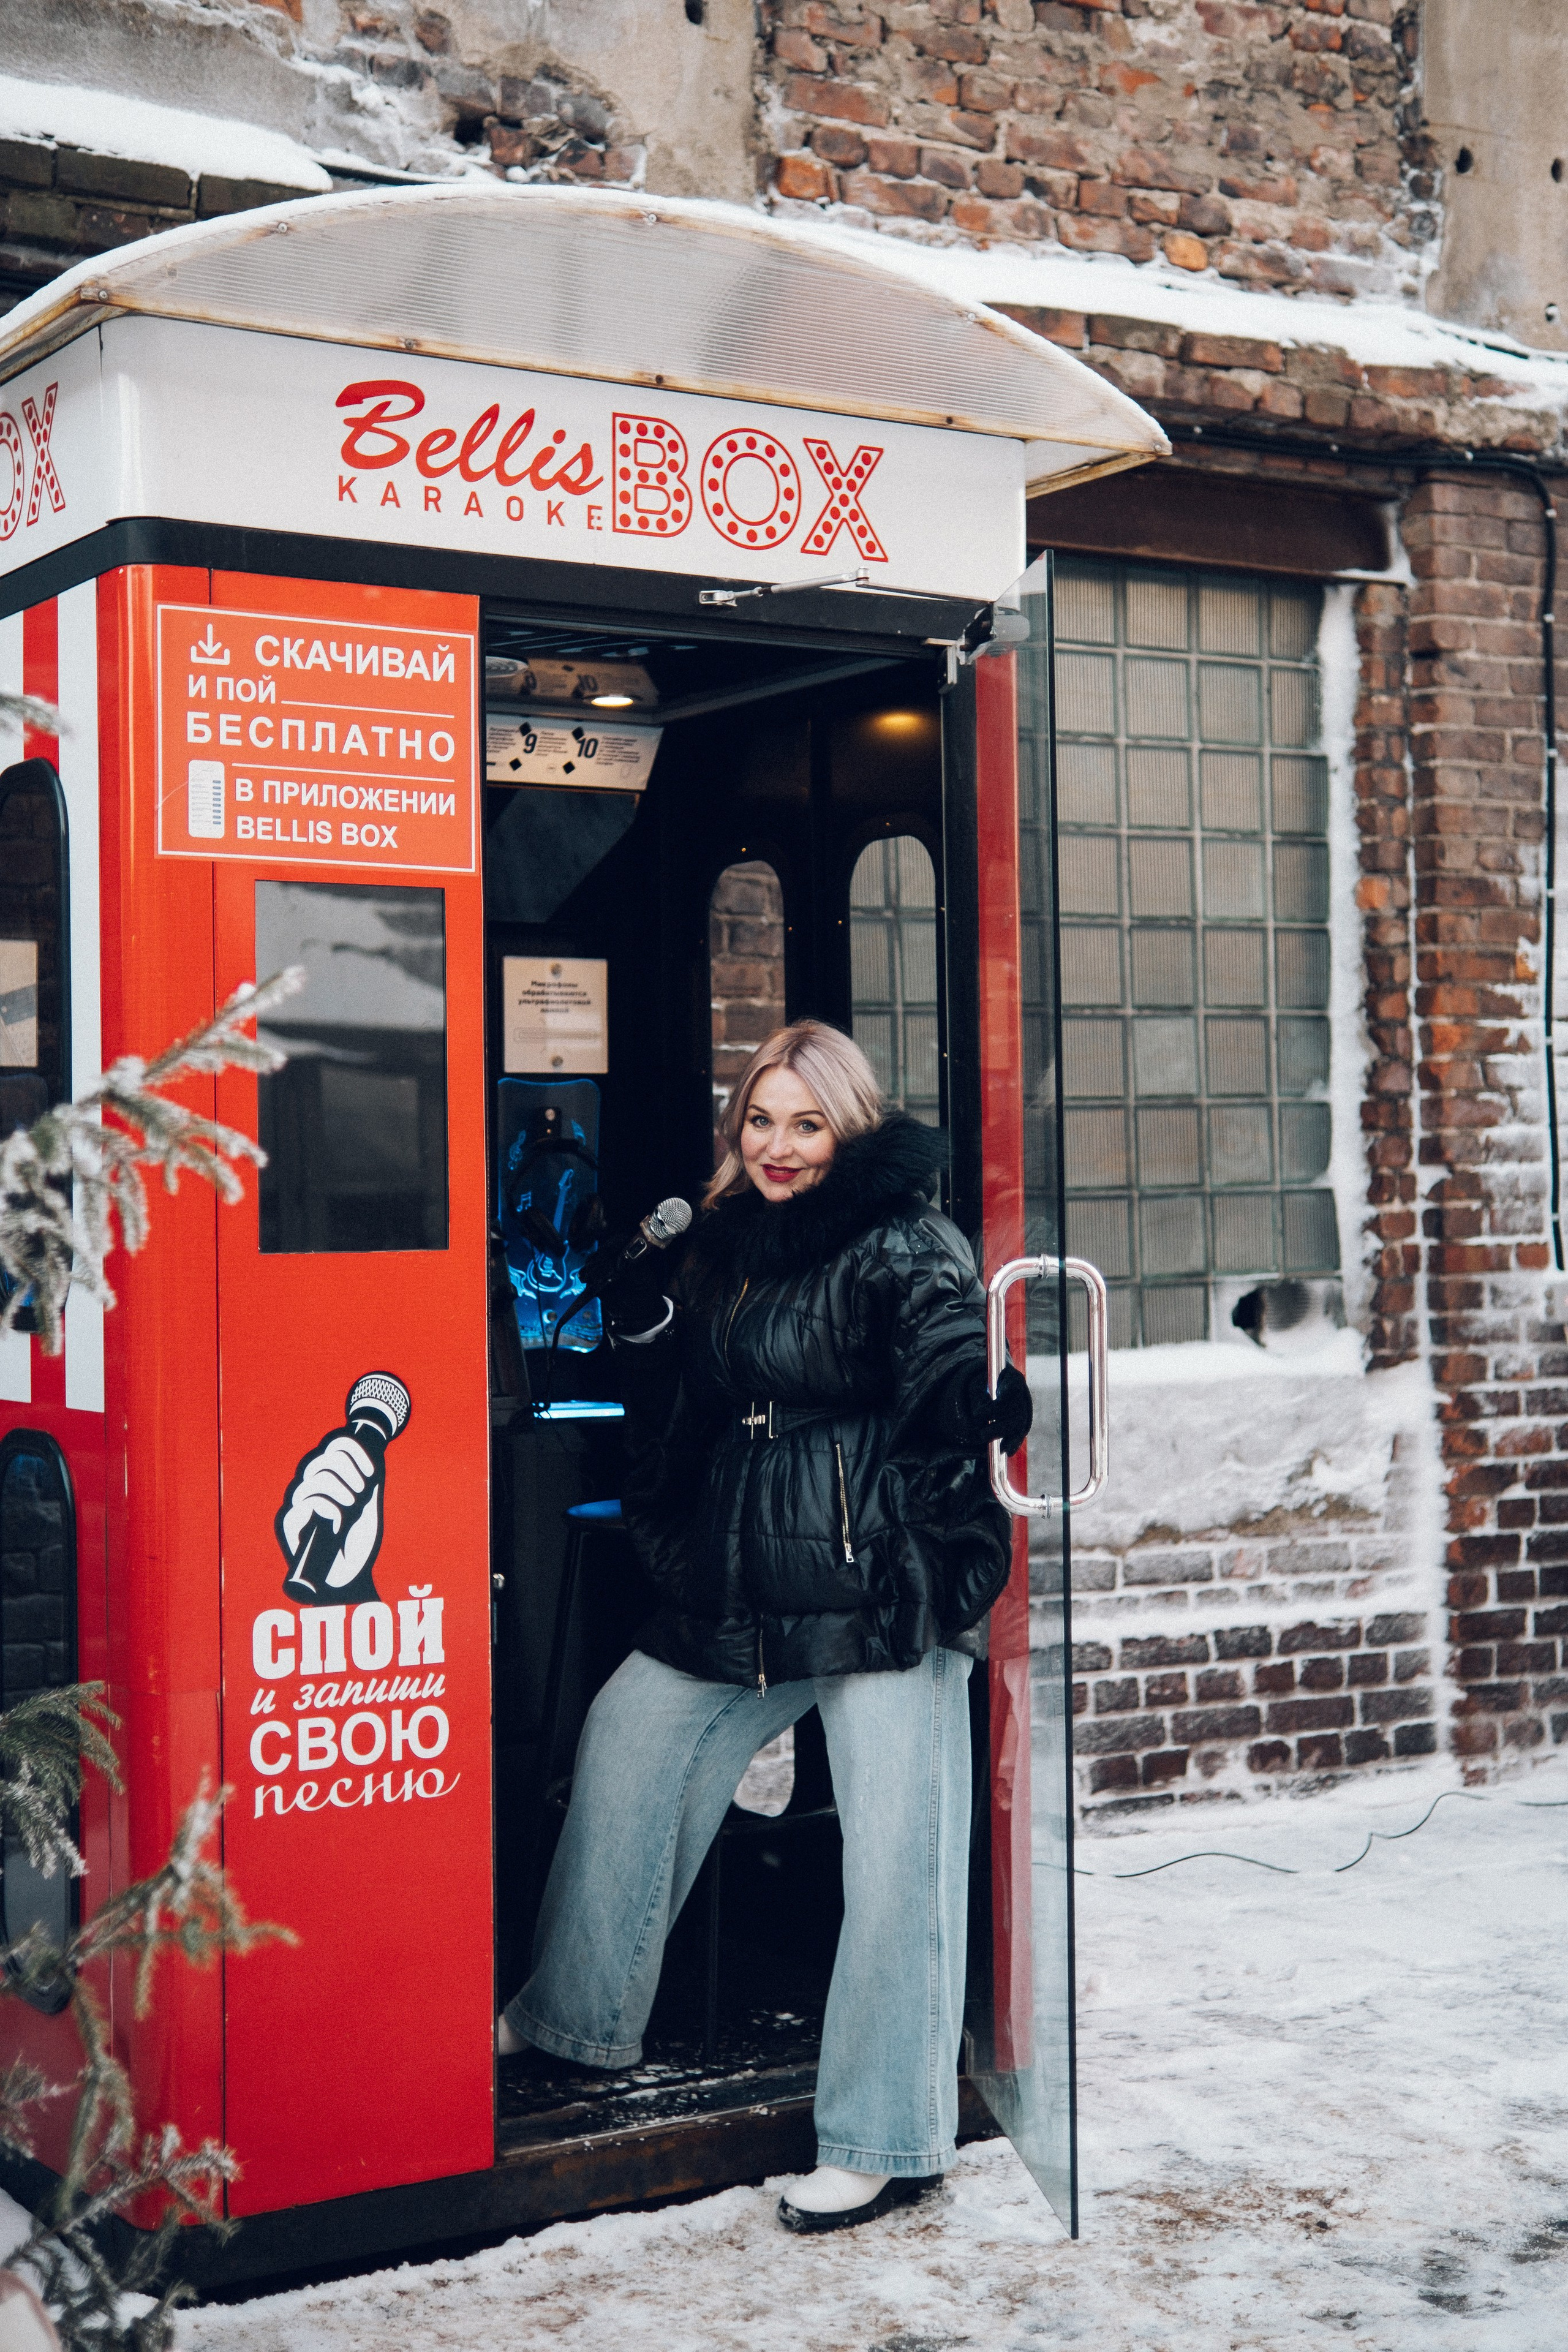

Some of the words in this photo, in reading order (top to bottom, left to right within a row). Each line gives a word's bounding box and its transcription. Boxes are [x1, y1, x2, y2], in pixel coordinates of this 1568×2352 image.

[335, 379, 604, 496] Bellis
[612, 412, 889, 563] BOX
[338, 475, 603, 531] KARAOKE
[254, 635, 455, 684] СКАЧИВАЙ
[188, 674, 206, 699] И
[216, 674, 276, 704] ПОЙ
[187, 710, 455, 763] БЕСПЛАТНО
[523, 733, 537, 754] 9
[577, 737, 598, 758] 10
[235, 778, 254, 802] В
[263, 780, 455, 816] ПРИЛОЖЕНИИ
[236, 815, 333, 844] BELLIS
[341, 822, 398, 849] BOX
[252, 1583, 445, 1680] СПОЙ
[250, 1688, 276, 1715] и
[293, 1672, 446, 1711] запиши
[249, 1705, 450, 1776] СВОЮ
[253, 1768, 461, 1819] песню
